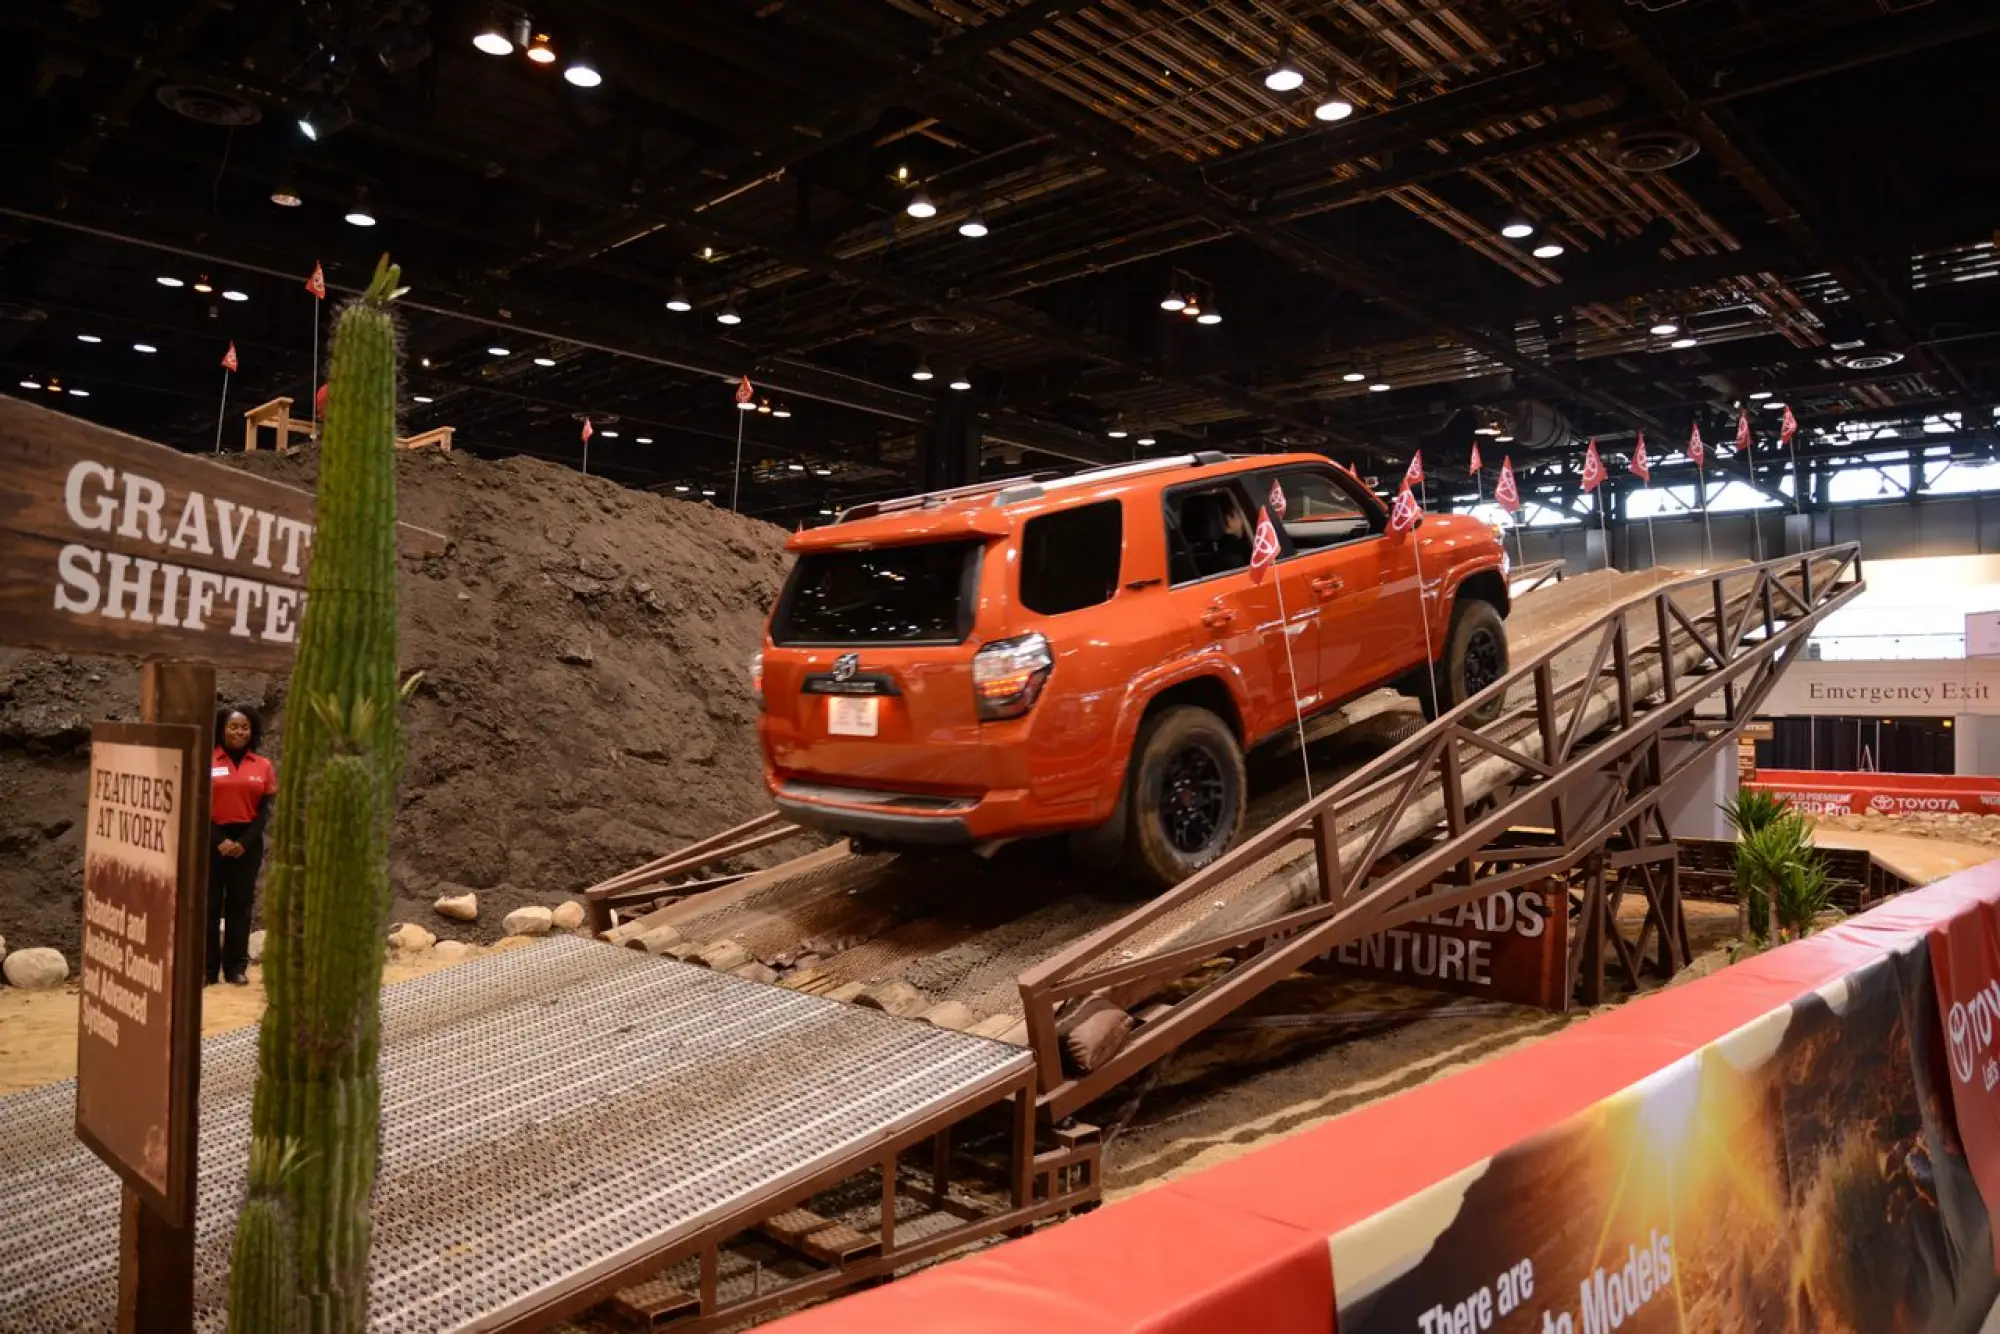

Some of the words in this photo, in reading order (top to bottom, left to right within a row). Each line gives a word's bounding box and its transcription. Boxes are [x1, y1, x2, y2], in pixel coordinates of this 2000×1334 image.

[64, 460, 317, 576] GRAVIT
[54, 544, 309, 643] SHIFTE
[1809, 682, 1935, 704] Emergency
[1942, 682, 1990, 700] Exit
[95, 769, 173, 813] FEATURES
[1895, 797, 1960, 810] TOYOTA
[96, 806, 114, 838] AT
[119, 810, 166, 853] WORK
[86, 890, 125, 936] Standard
[127, 912, 147, 945] and
[85, 925, 123, 972] Available
[125, 945, 163, 993] Control
[83, 966, 99, 997] and
[100, 970, 147, 1025] Advanced
[83, 994, 119, 1047] Systems
[1418, 1286, 1492, 1334] There
[1497, 1257, 1534, 1316] are
[1580, 1228, 1673, 1334] Models
